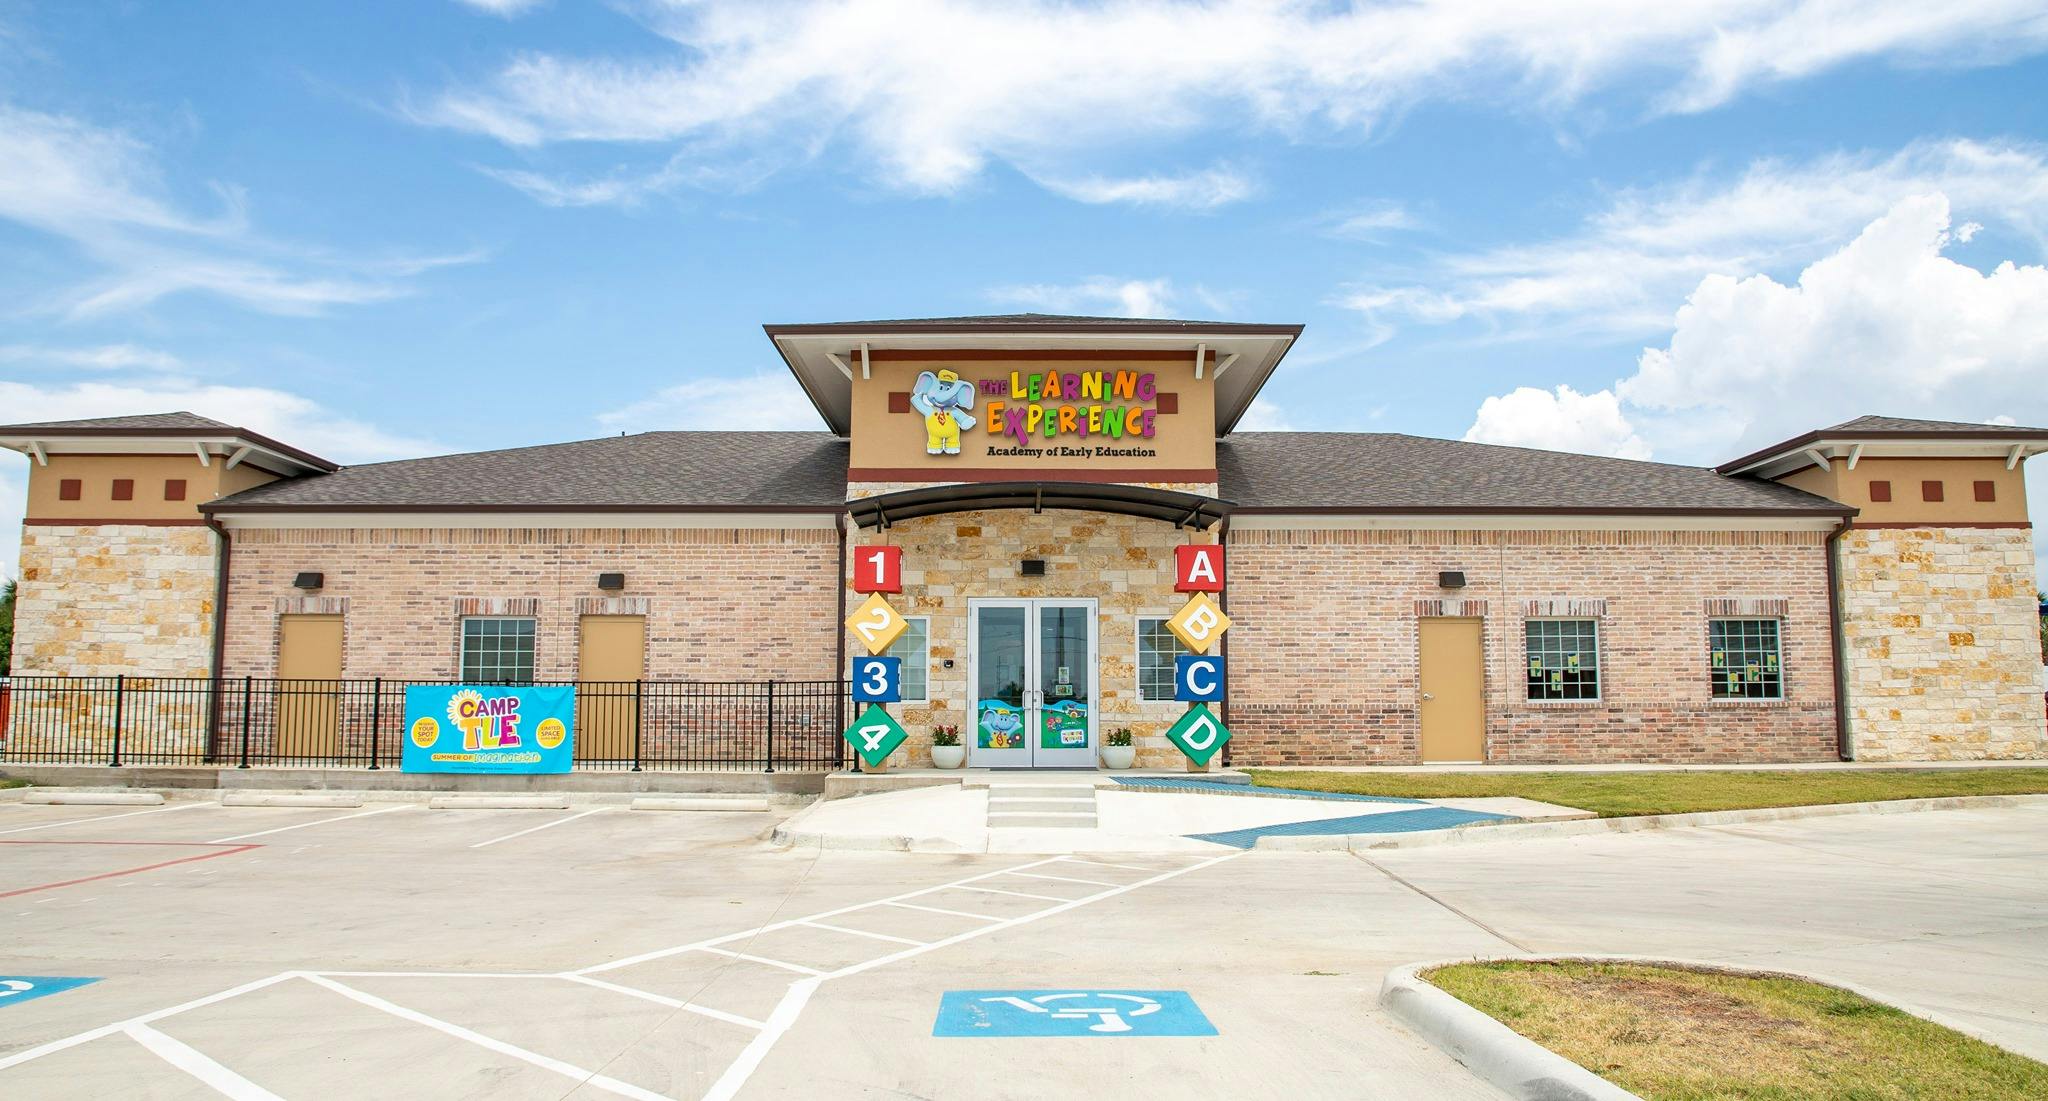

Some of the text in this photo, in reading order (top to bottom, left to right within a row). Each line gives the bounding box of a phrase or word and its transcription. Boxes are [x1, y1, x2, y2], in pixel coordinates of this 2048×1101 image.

[979, 379, 1008, 395] THE
[987, 446, 1156, 459] Academy of Early Education
[868, 551, 885, 584] 1
[1187, 550, 1217, 583] A
[856, 607, 891, 642] 2
[1182, 604, 1218, 640] B
[862, 661, 888, 696] 3
[1186, 660, 1217, 696] C
[459, 697, 520, 718] CAMP
[459, 714, 521, 749] TLE
[858, 724, 891, 752] 4
[1181, 713, 1217, 751] D
